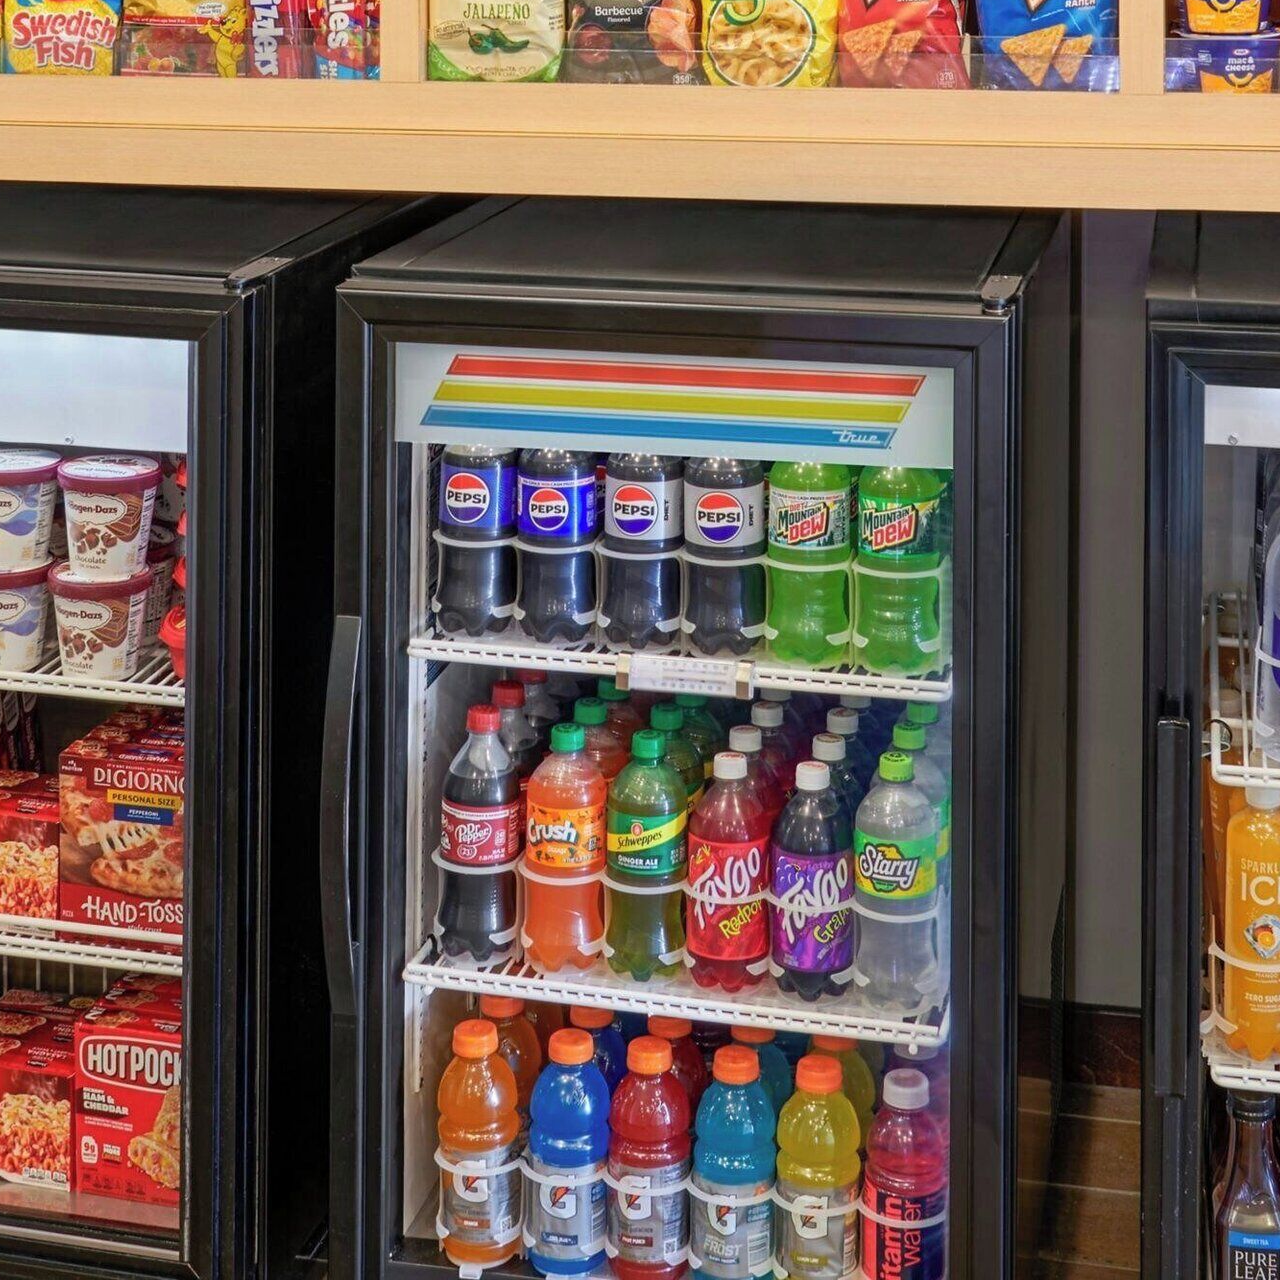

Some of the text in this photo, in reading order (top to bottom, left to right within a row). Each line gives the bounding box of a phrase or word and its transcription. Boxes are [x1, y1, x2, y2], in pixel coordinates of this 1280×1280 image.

[463, 1, 530, 20] JALAPEÑO
[595, 6, 643, 16] Barbecue
[13, 10, 117, 47] Swedish
[36, 36, 95, 69] Fish
[833, 429, 879, 445] true
[447, 490, 487, 504] PEPSI
[531, 503, 566, 516] PEPSI
[613, 502, 655, 516] PEPSI
[697, 510, 740, 524] PEPSI
[112, 793, 176, 806] PERSONAL SIZE
[529, 819, 576, 841] Crush
[618, 832, 663, 847] Schweppes
[860, 844, 920, 888] Starry
[694, 847, 761, 929] Faygo
[1245, 992, 1264, 1001] ZERO
[83, 1090, 105, 1103] HAM
[83, 1100, 128, 1116] CHEDDAR
[1235, 1251, 1278, 1268] PURE
